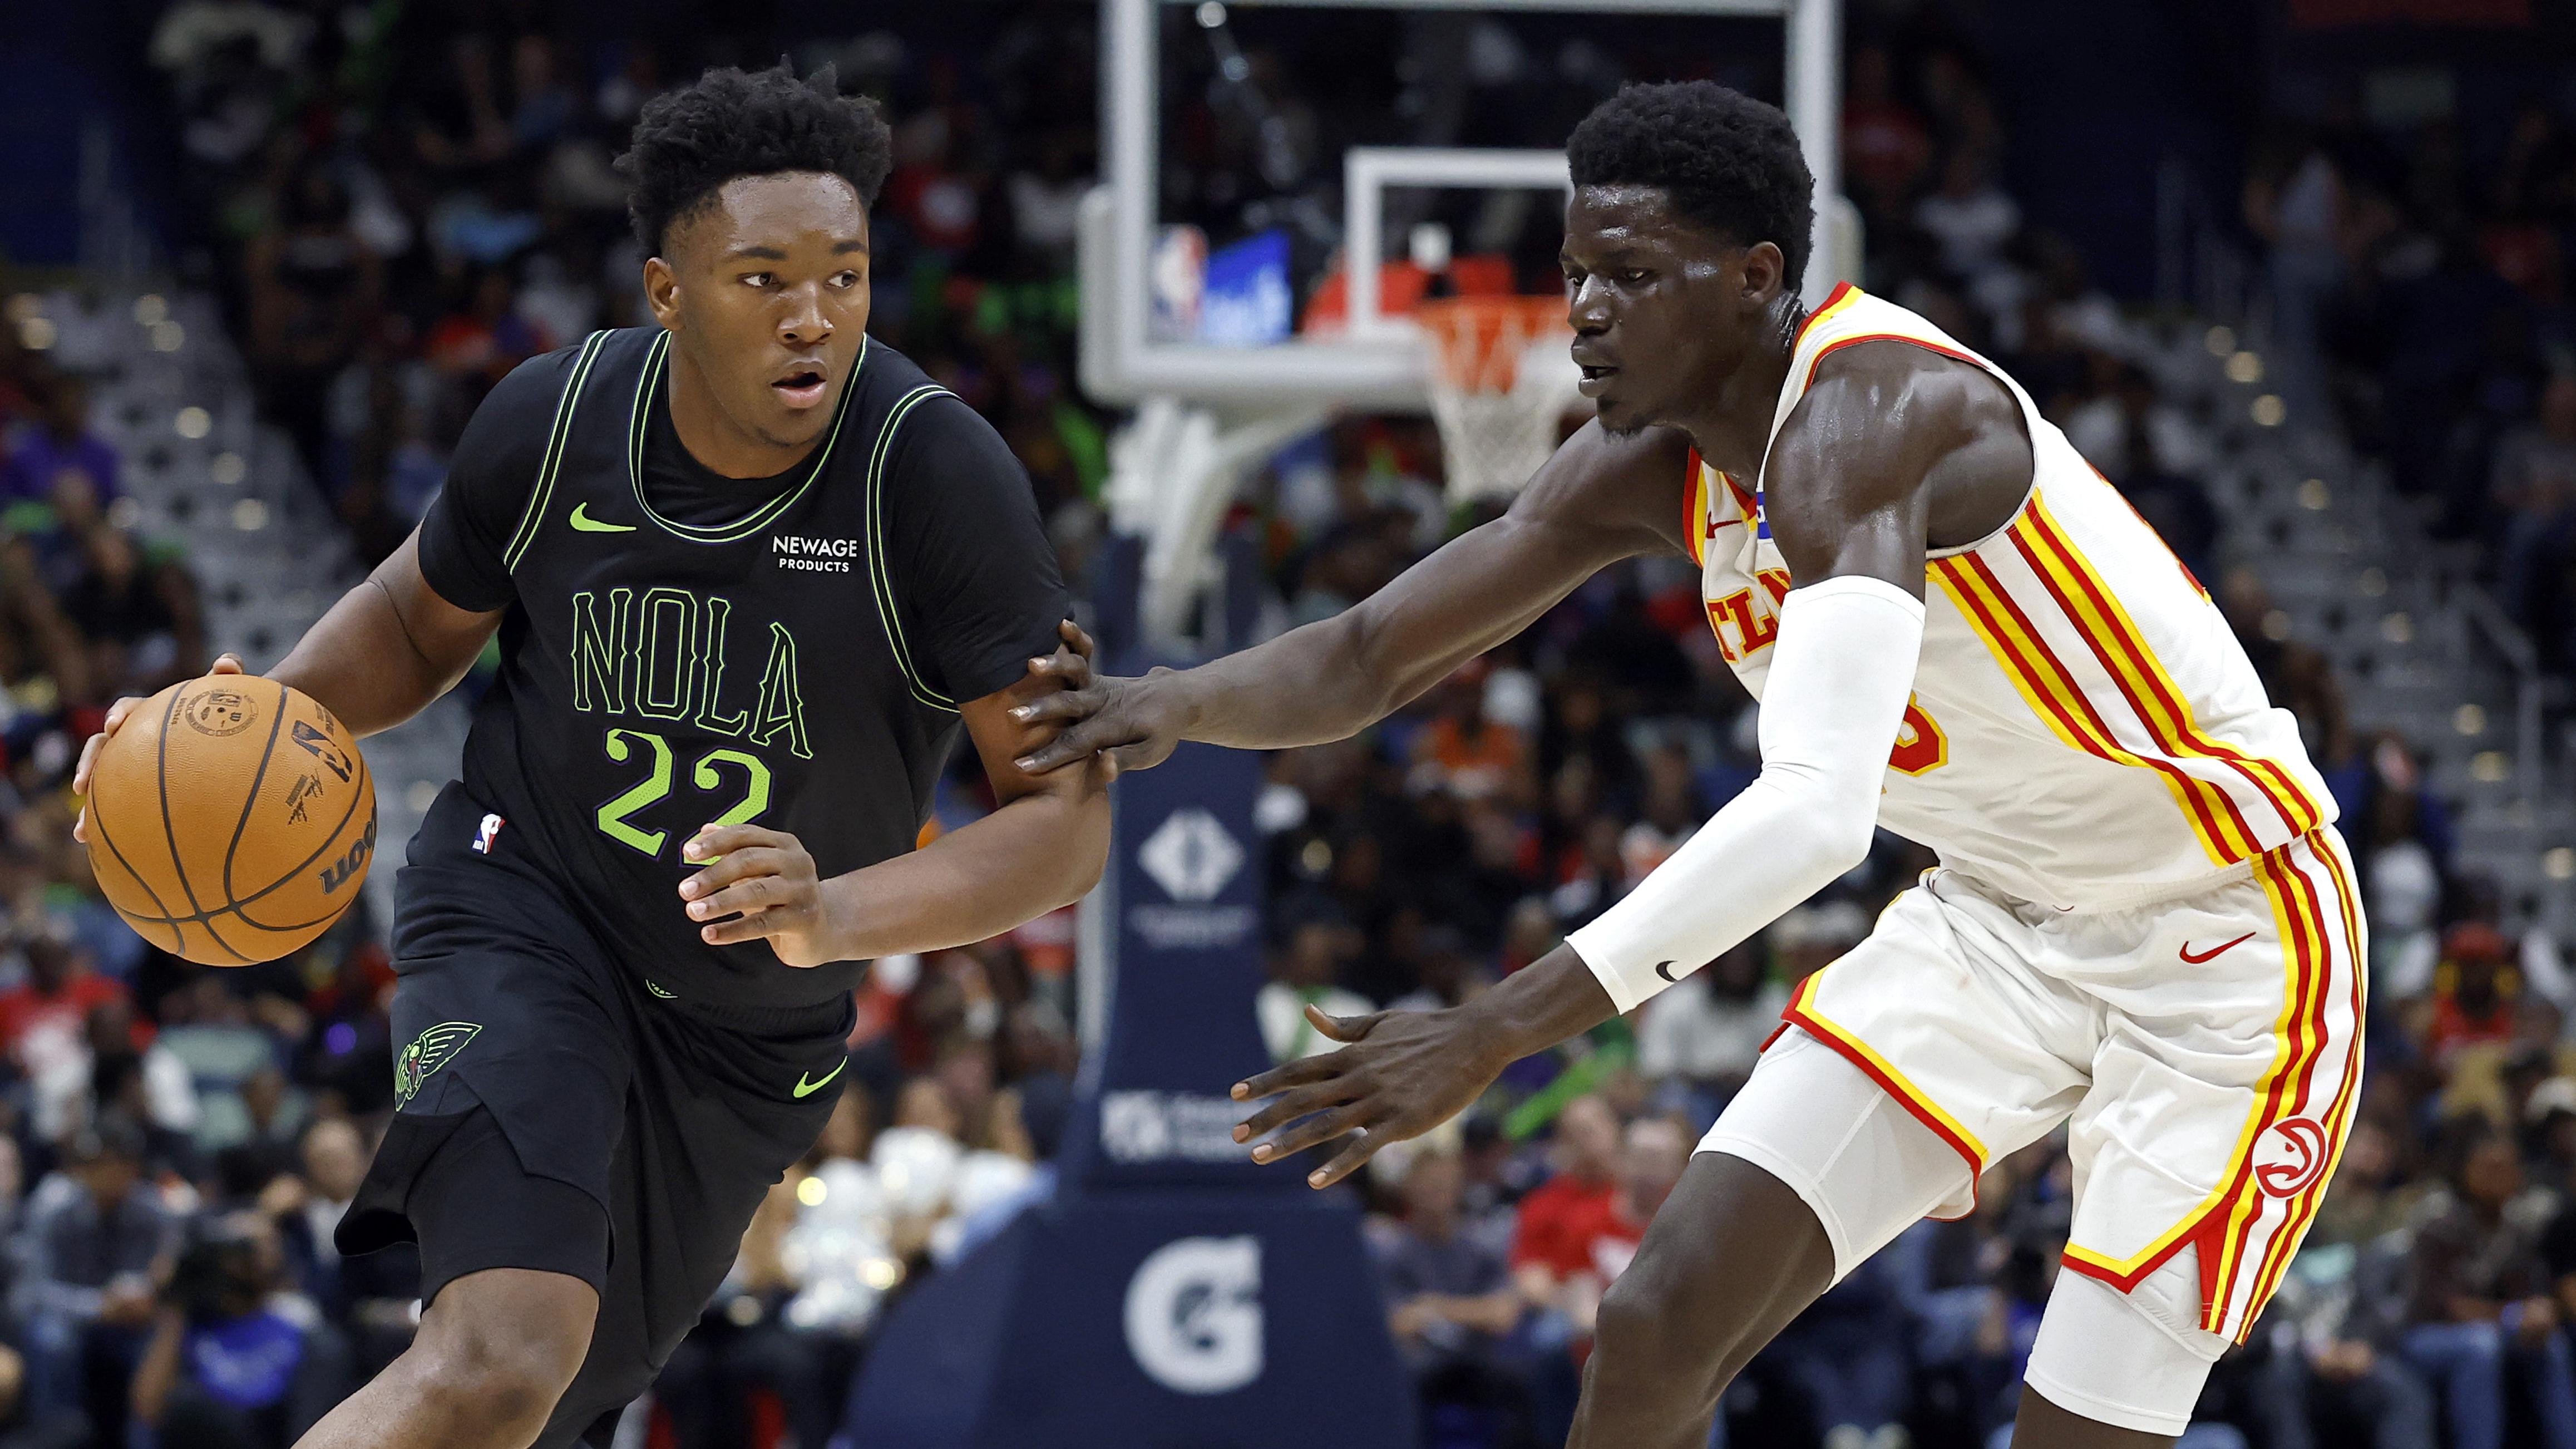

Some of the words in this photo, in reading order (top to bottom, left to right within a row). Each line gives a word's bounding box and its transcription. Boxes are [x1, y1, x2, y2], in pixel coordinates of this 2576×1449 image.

[772, 535, 857, 557] NEWAGE
[779, 558, 850, 573] PRODUCTS
[571, 588, 814, 759] NOLA
[595, 727, 773, 867] 22
[1123, 1235, 1265, 1394] G
